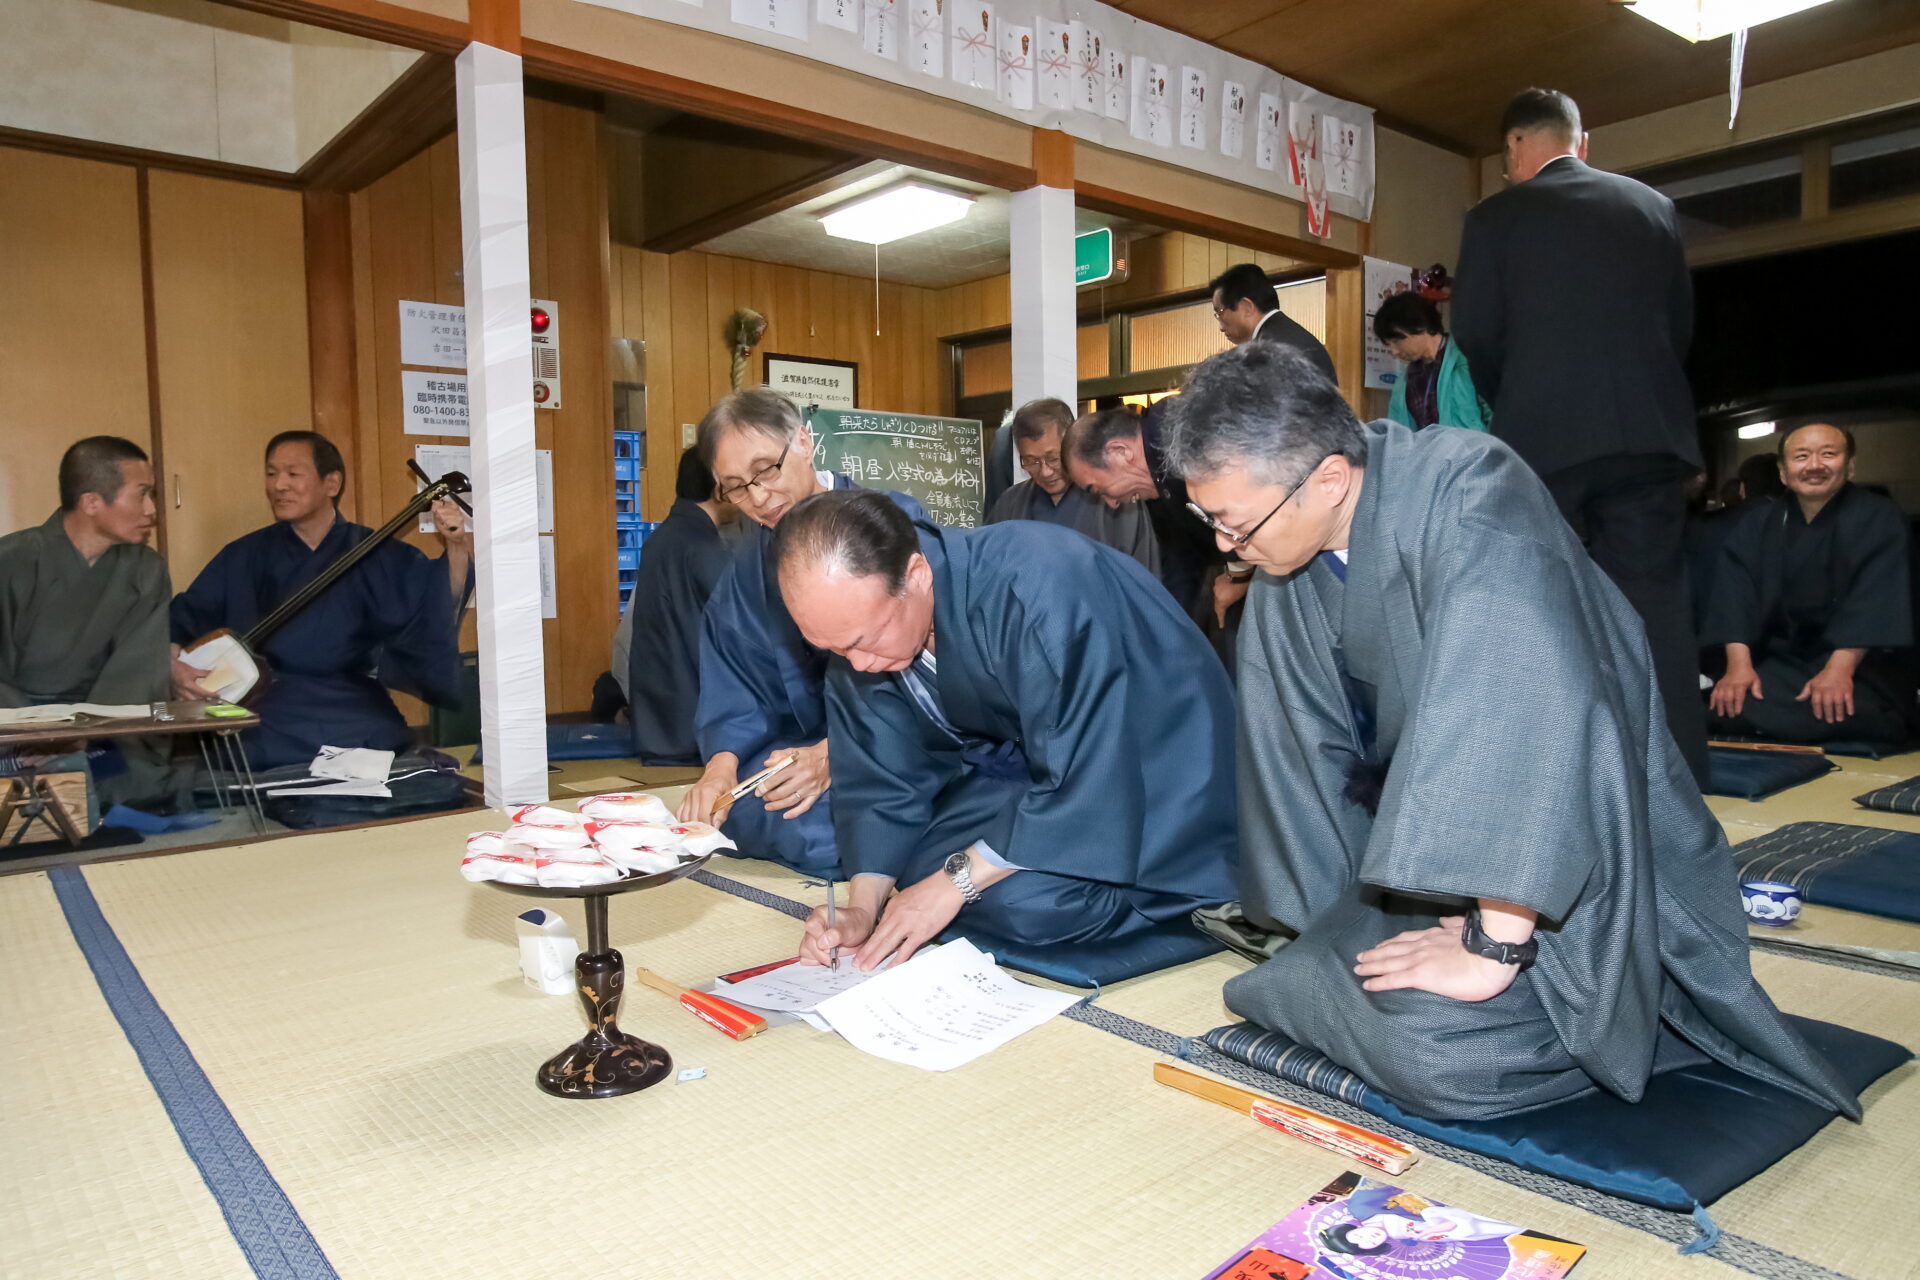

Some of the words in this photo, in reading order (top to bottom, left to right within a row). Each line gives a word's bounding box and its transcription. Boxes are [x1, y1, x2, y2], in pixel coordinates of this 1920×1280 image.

[1190, 73, 1200, 97] 御祝
[426, 380, 466, 392] 稽古場用
[417, 392, 469, 406] 臨時携帯電
